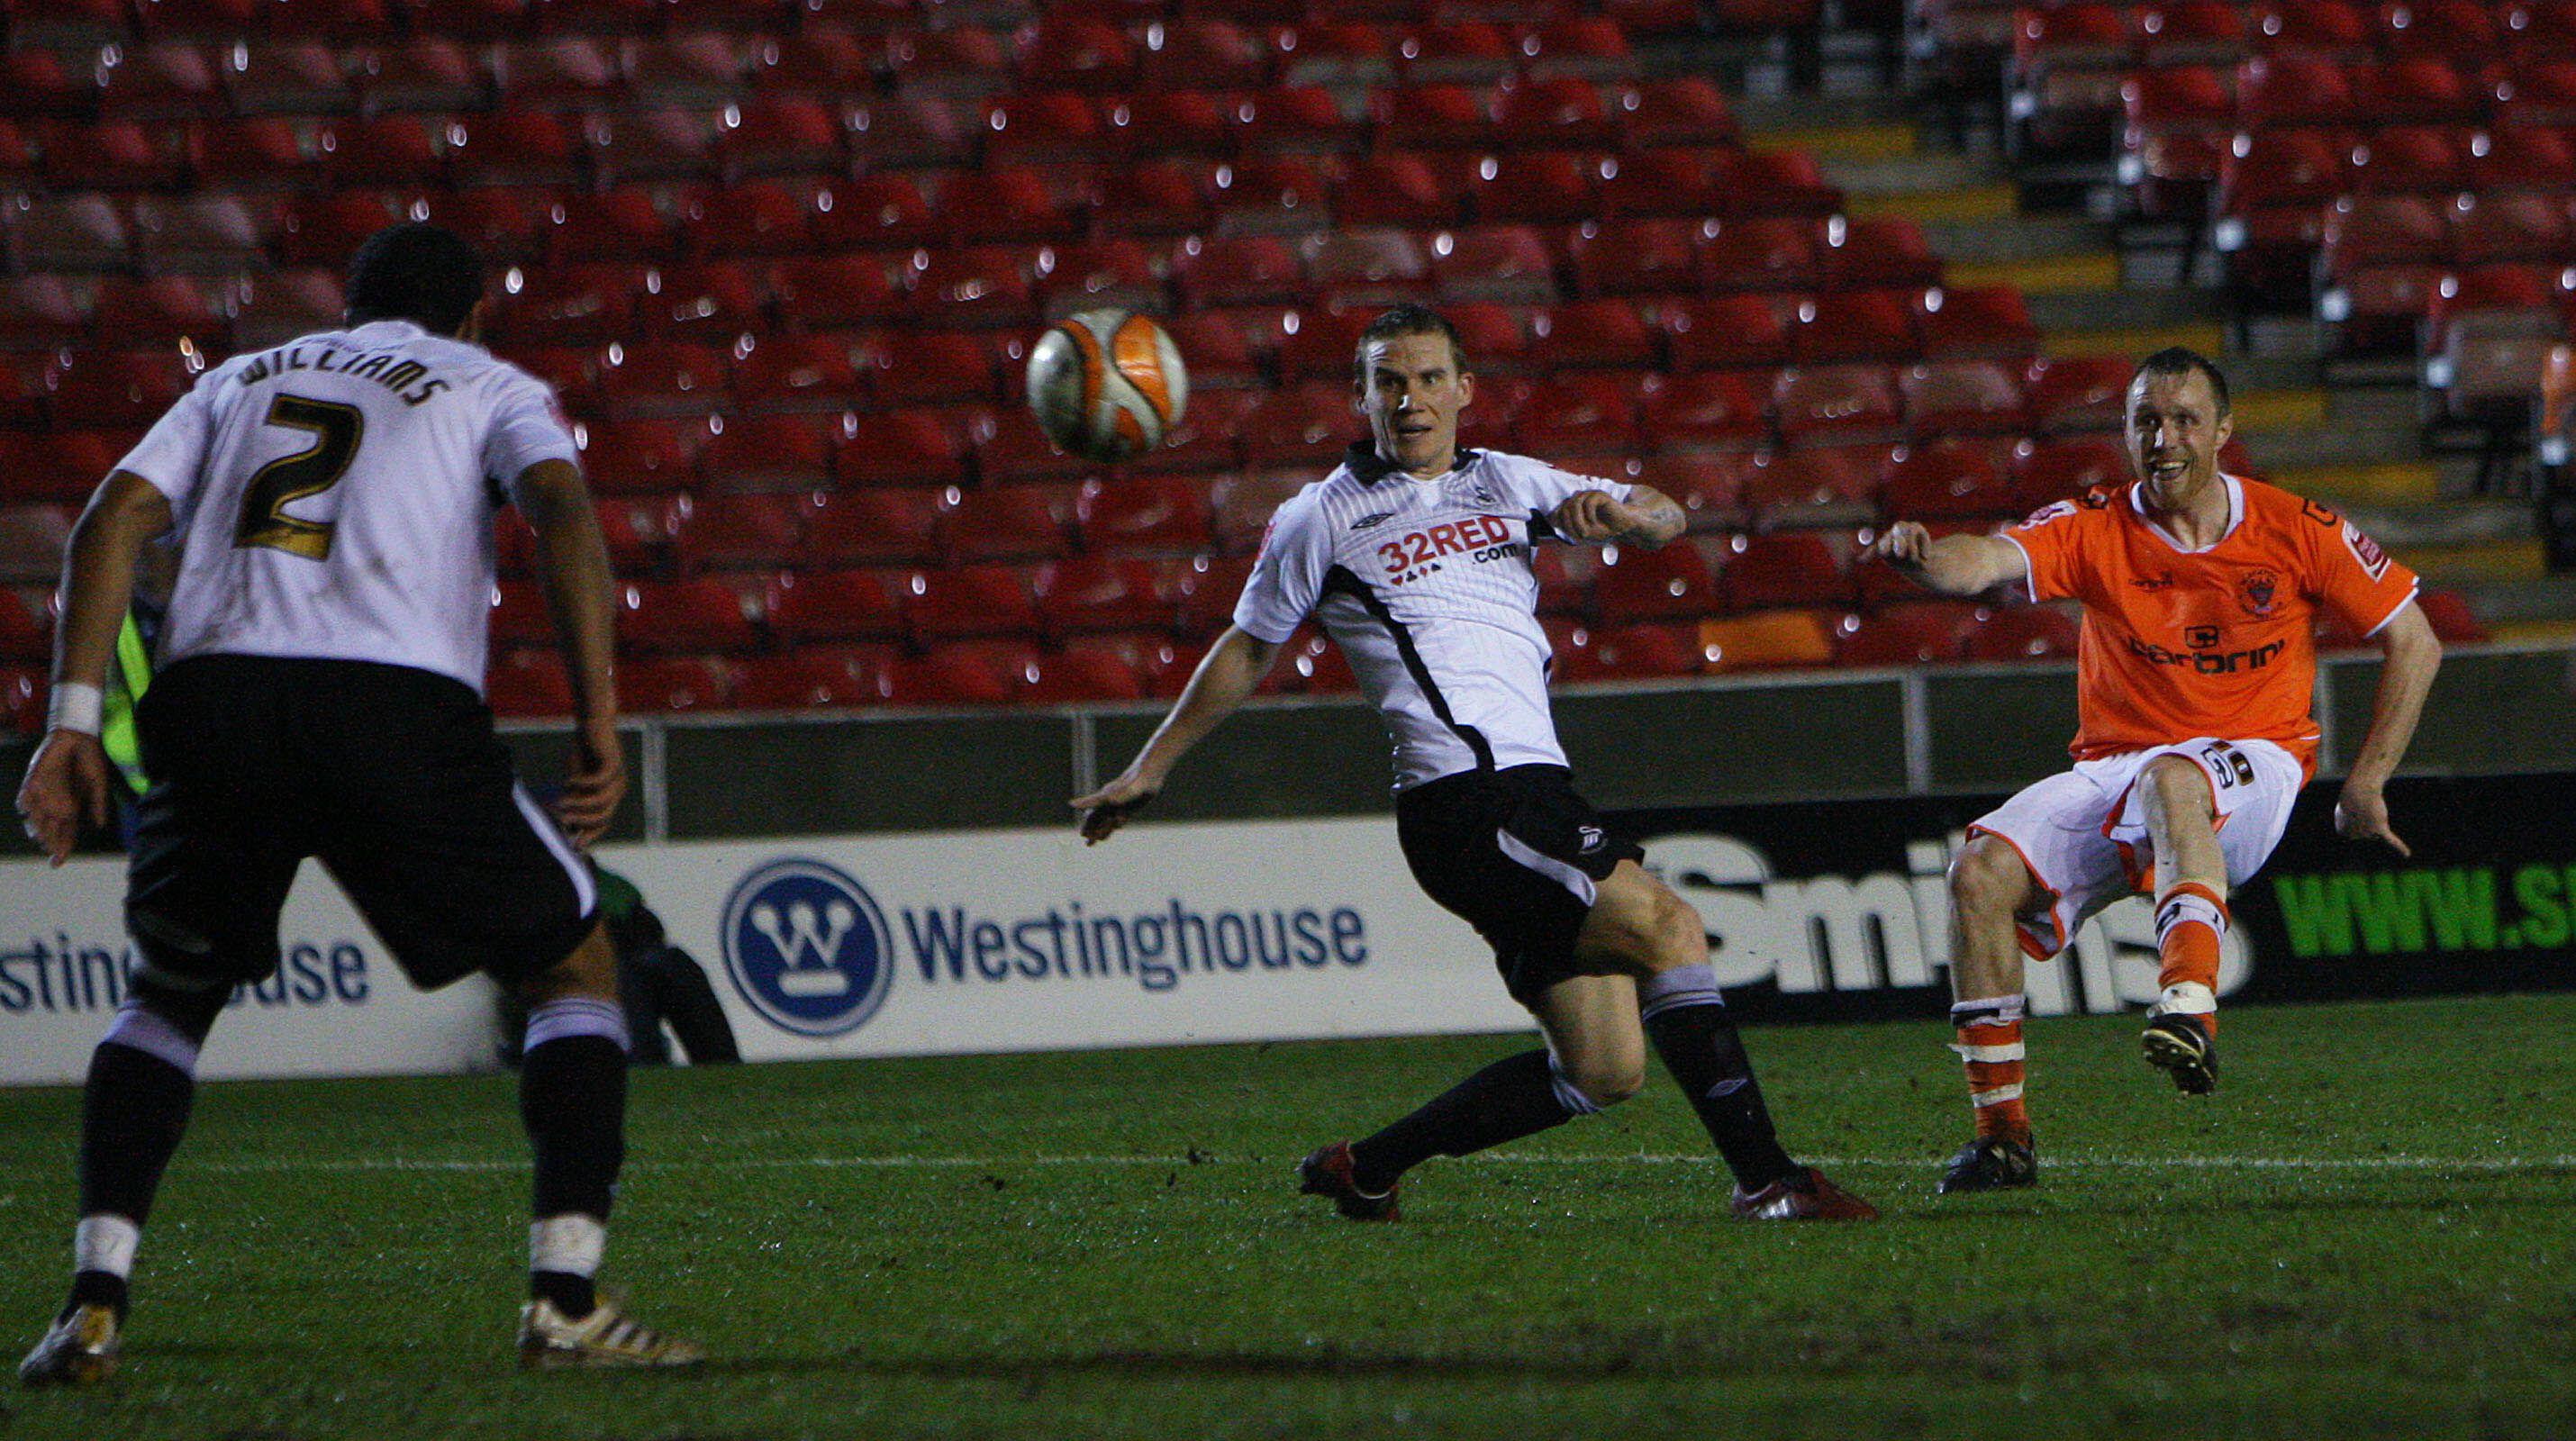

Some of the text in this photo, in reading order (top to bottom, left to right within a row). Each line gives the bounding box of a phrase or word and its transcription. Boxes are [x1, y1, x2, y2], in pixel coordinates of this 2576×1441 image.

[238, 347, 452, 407] WILLIAMS
[231, 392, 364, 563] 2
[1376, 515, 1510, 574] 32RED
[902, 899, 1367, 991] Westinghouse
[1637, 829, 2251, 1016] Smihs
